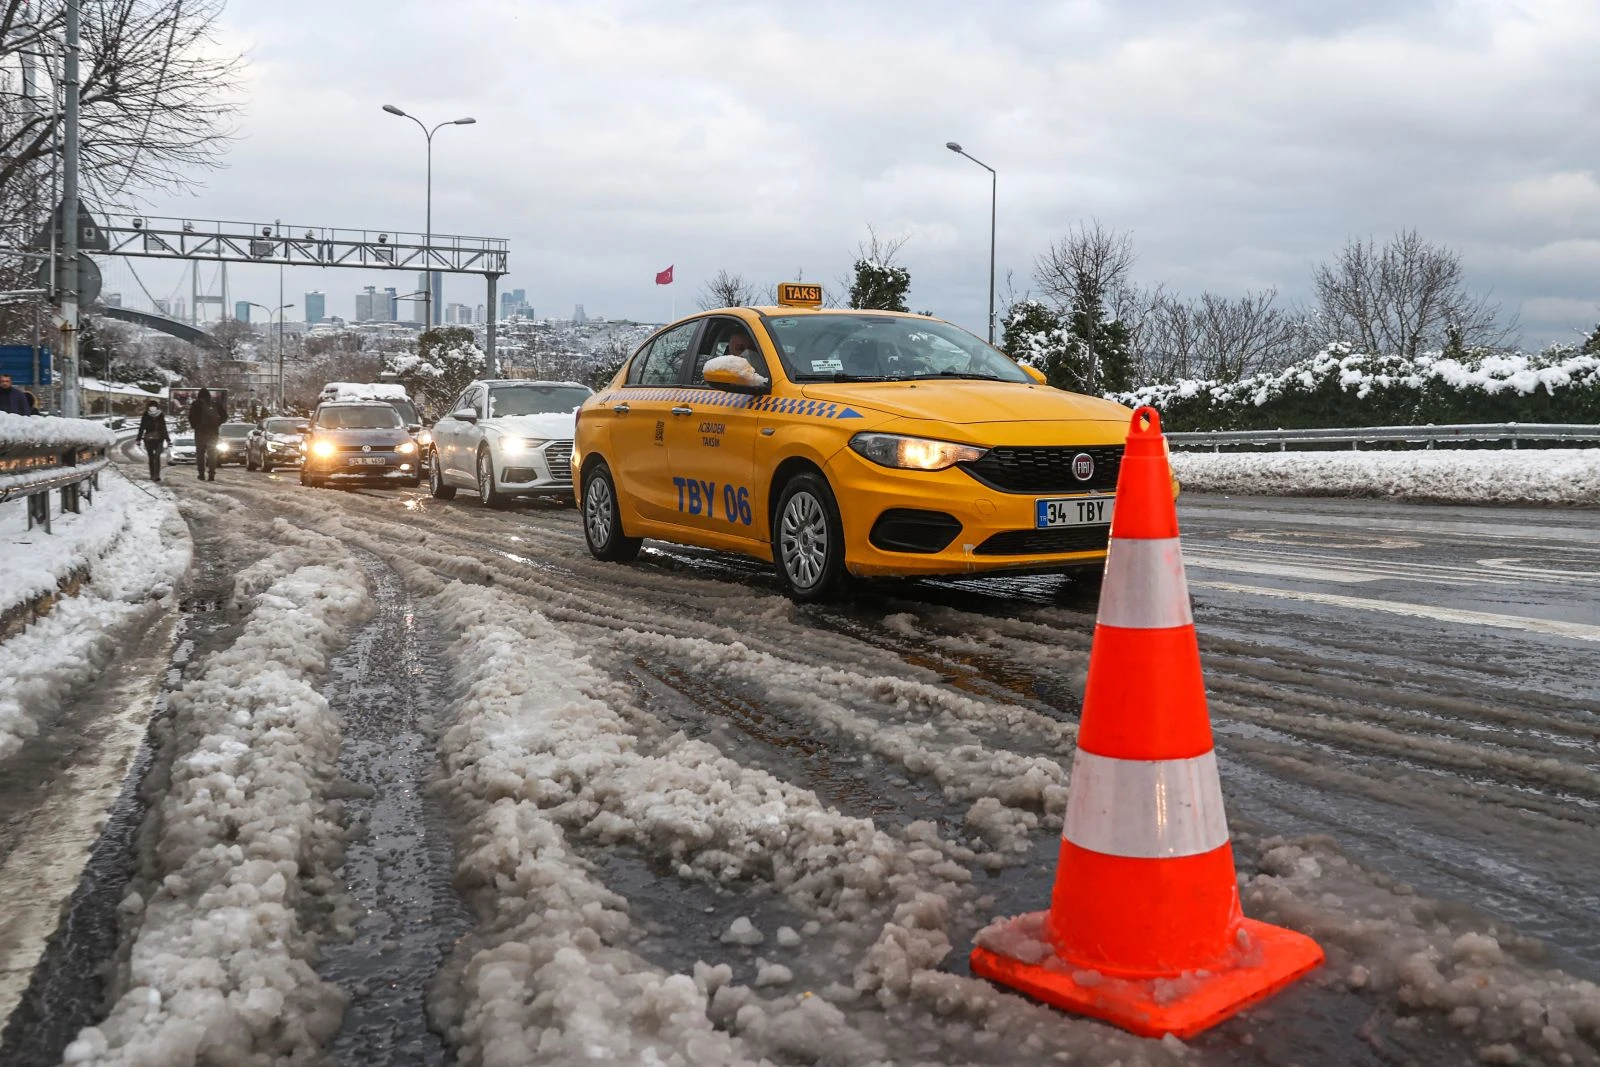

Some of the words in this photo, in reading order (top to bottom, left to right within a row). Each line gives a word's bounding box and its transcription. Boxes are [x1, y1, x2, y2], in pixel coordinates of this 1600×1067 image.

[1077, 461, 1090, 474] FIAT
[673, 477, 716, 518] TBY
[723, 484, 752, 526] 06
[1048, 503, 1066, 524] 34
[1077, 501, 1104, 522] TBY
